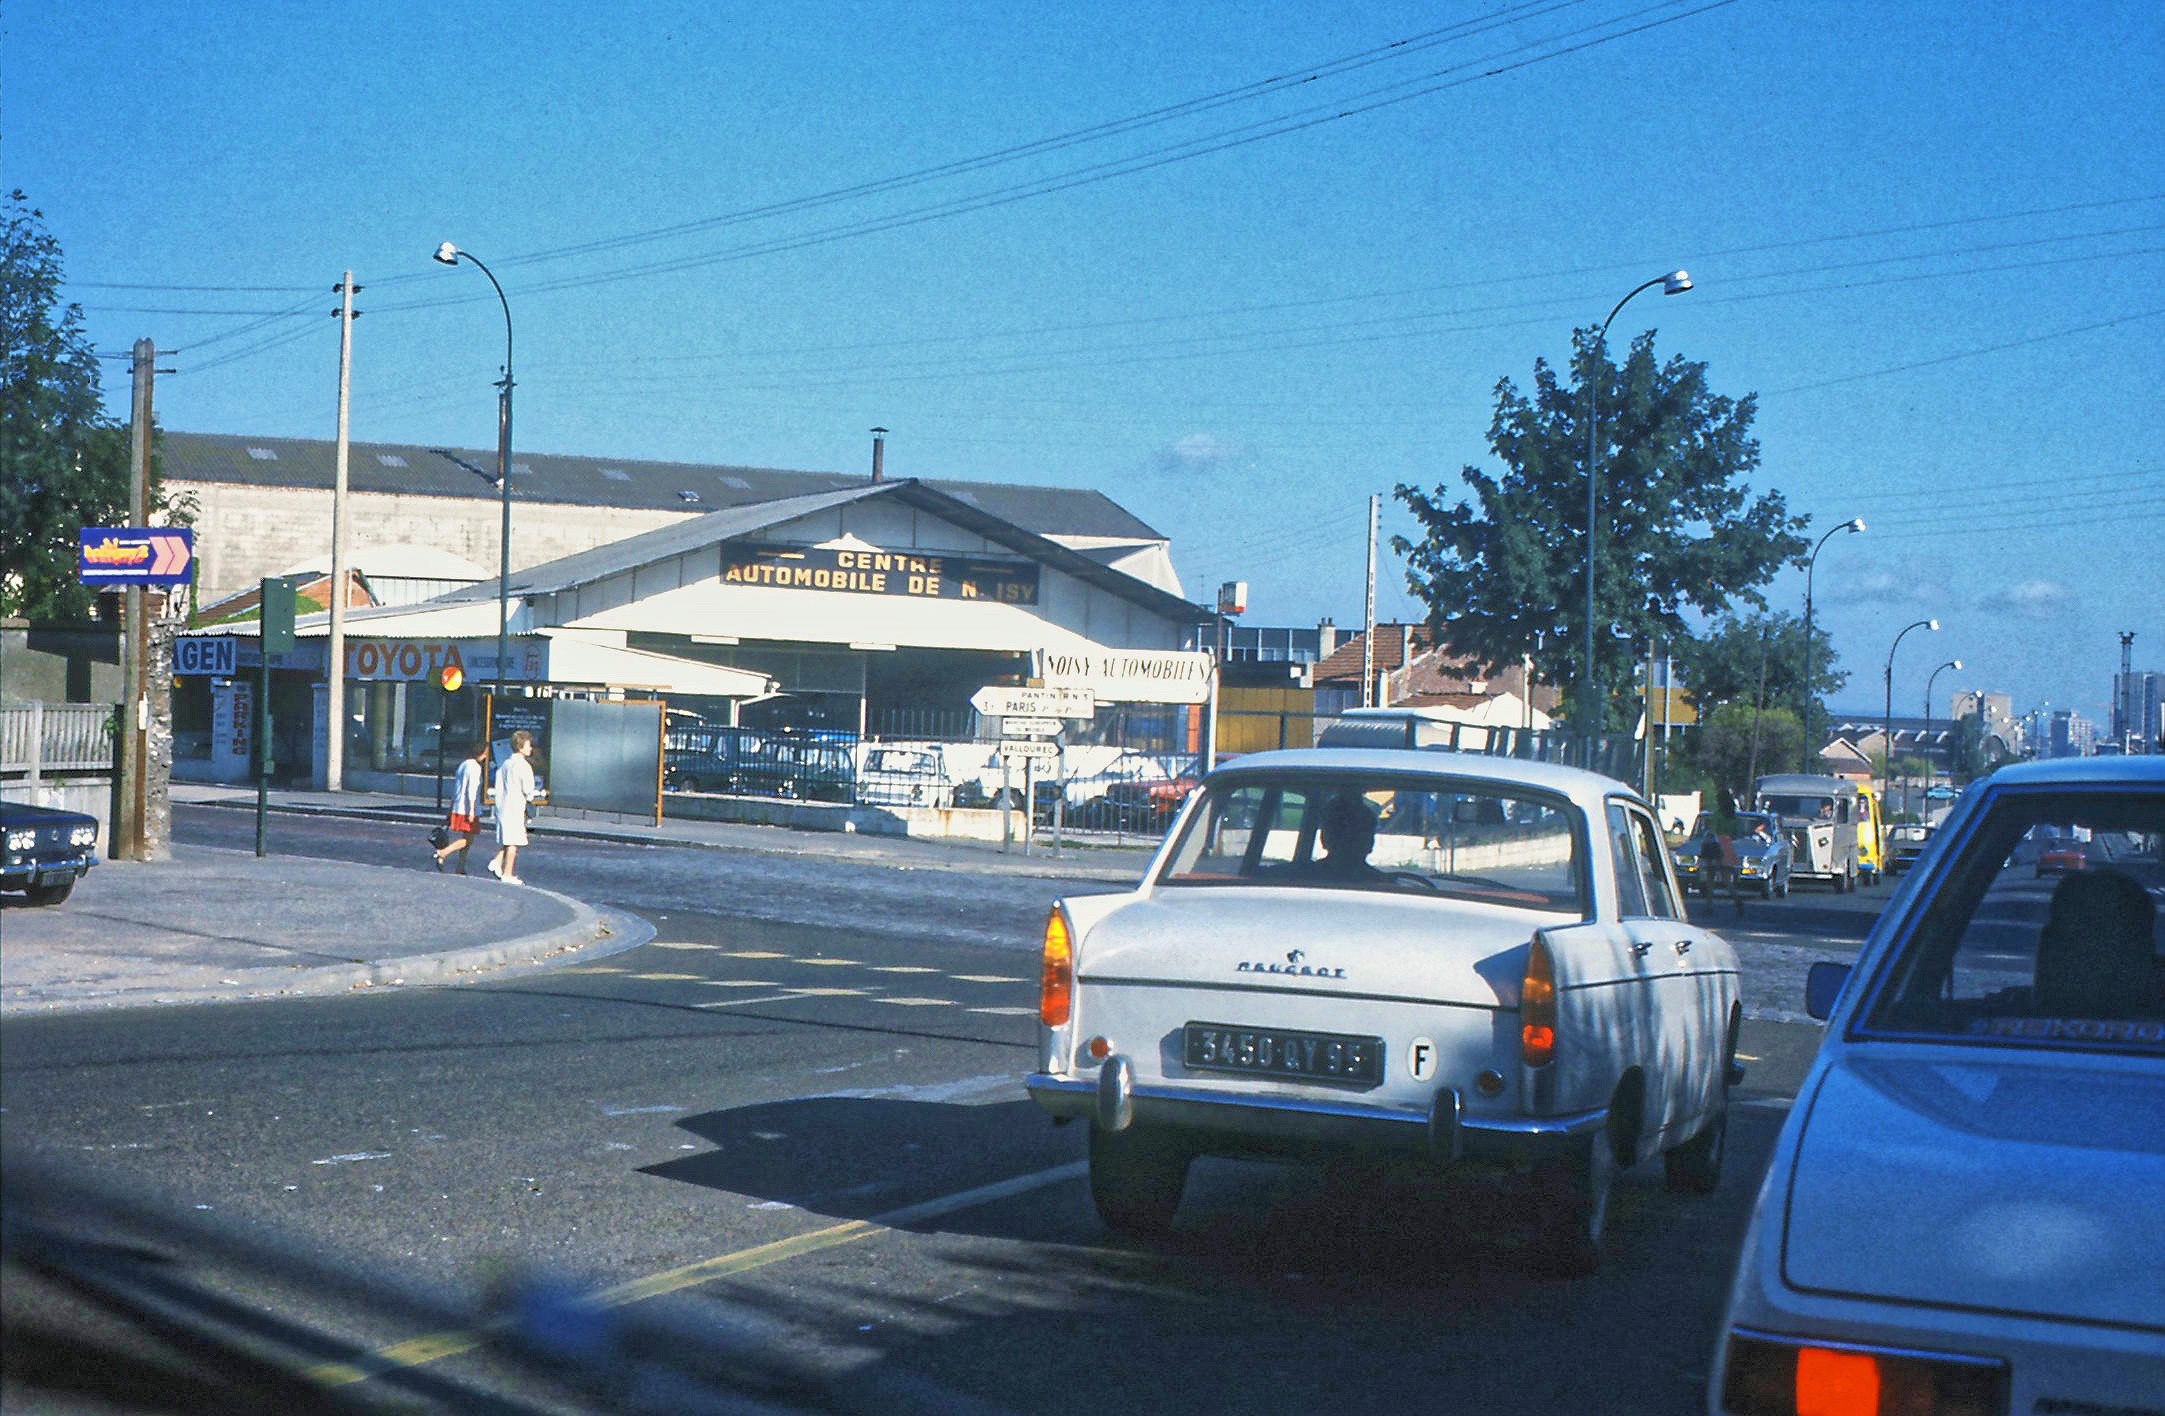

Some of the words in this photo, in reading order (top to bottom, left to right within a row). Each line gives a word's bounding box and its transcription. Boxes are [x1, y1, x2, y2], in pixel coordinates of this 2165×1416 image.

[838, 551, 942, 574] CENTRE
[726, 564, 886, 592] AUTOMOBILE
[908, 575, 940, 595] DE
[961, 580, 1036, 600] NISY
[343, 643, 466, 678] TOYOTA
[1006, 701, 1036, 713] PARIS
[232, 693, 249, 755] PARKING
[1004, 744, 1054, 754] VALLOUREC
[1202, 1031, 1273, 1066] 3450
[1415, 1044, 1430, 1076] F
